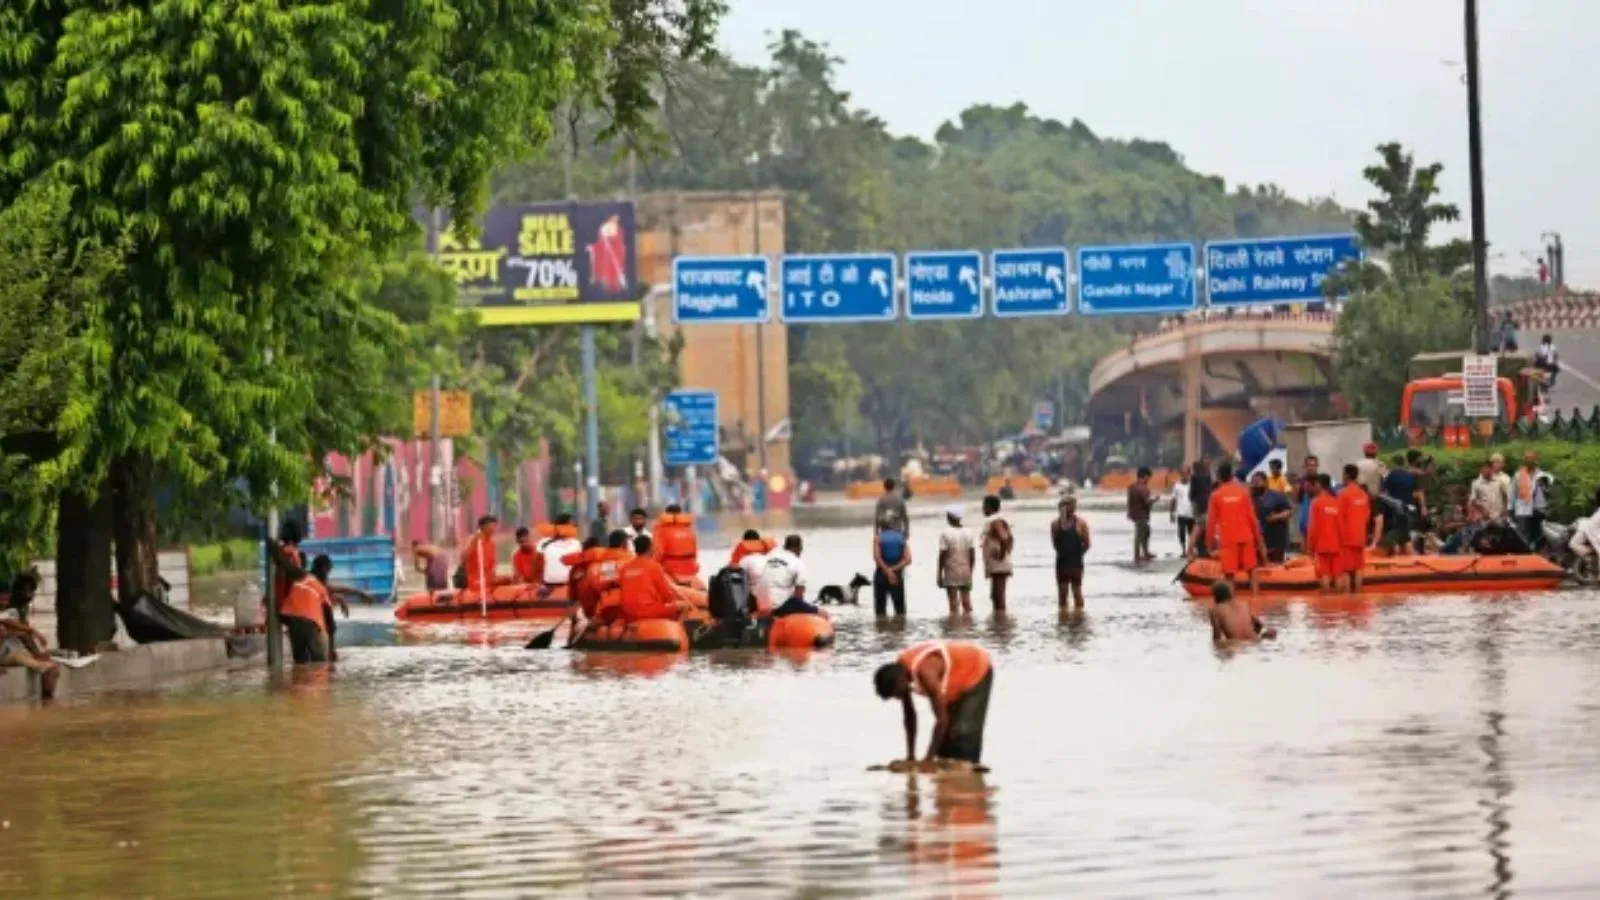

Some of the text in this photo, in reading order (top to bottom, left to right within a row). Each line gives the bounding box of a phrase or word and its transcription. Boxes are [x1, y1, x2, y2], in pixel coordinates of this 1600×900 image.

[522, 214, 568, 231] MEGA
[518, 230, 575, 256] SALE
[525, 259, 577, 288] 70%
[1084, 283, 1174, 299] Gandhi Nagar
[1210, 275, 1245, 291] Delhi
[1253, 273, 1308, 292] Railway
[913, 289, 954, 305] Noida
[997, 285, 1053, 301] Ashram
